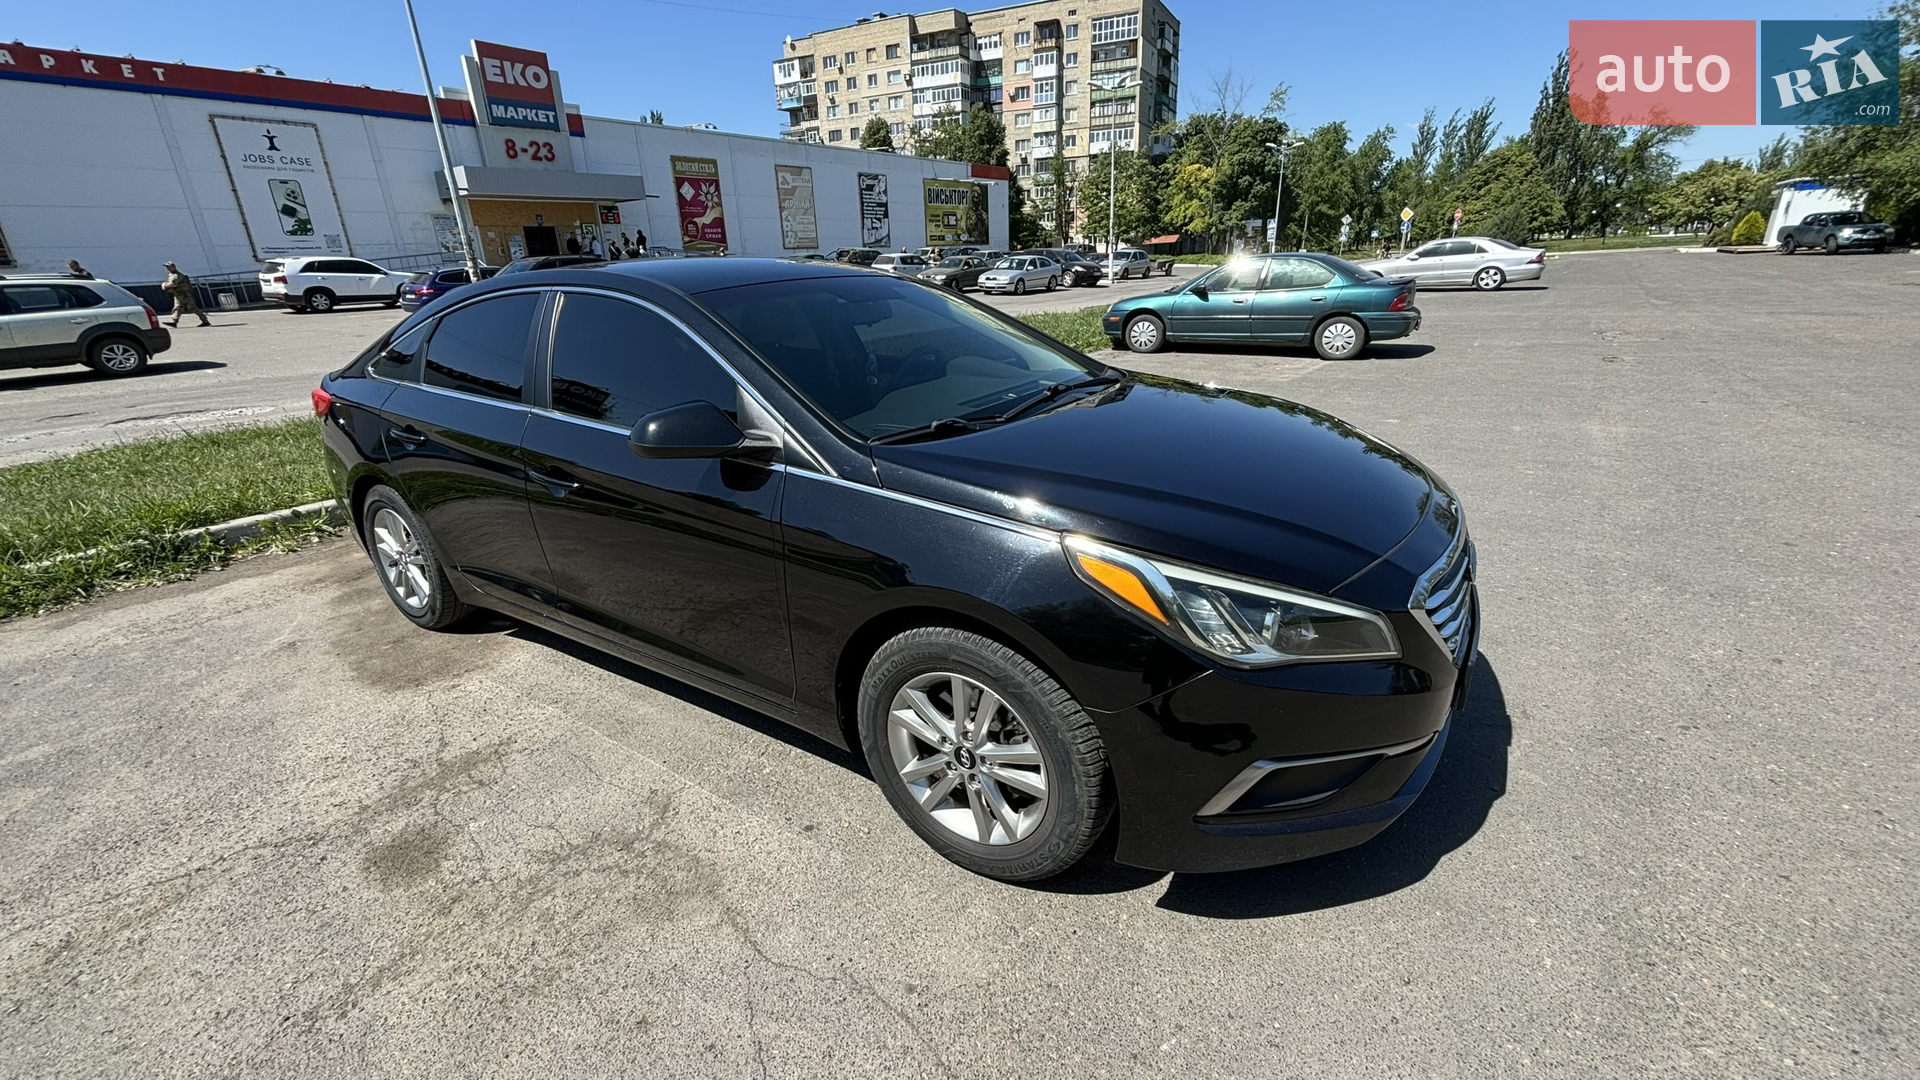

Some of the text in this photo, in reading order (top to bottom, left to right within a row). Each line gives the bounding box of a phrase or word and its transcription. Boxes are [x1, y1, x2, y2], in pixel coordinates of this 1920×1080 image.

[482, 57, 548, 89] ЕКО
[491, 103, 555, 123] МАРКЕТ
[241, 153, 312, 166] JOBS CASE
[505, 138, 556, 162] 8-23
[927, 184, 969, 206] ВІЙСЬКТОРГ
[909, 651, 941, 661] ST582
